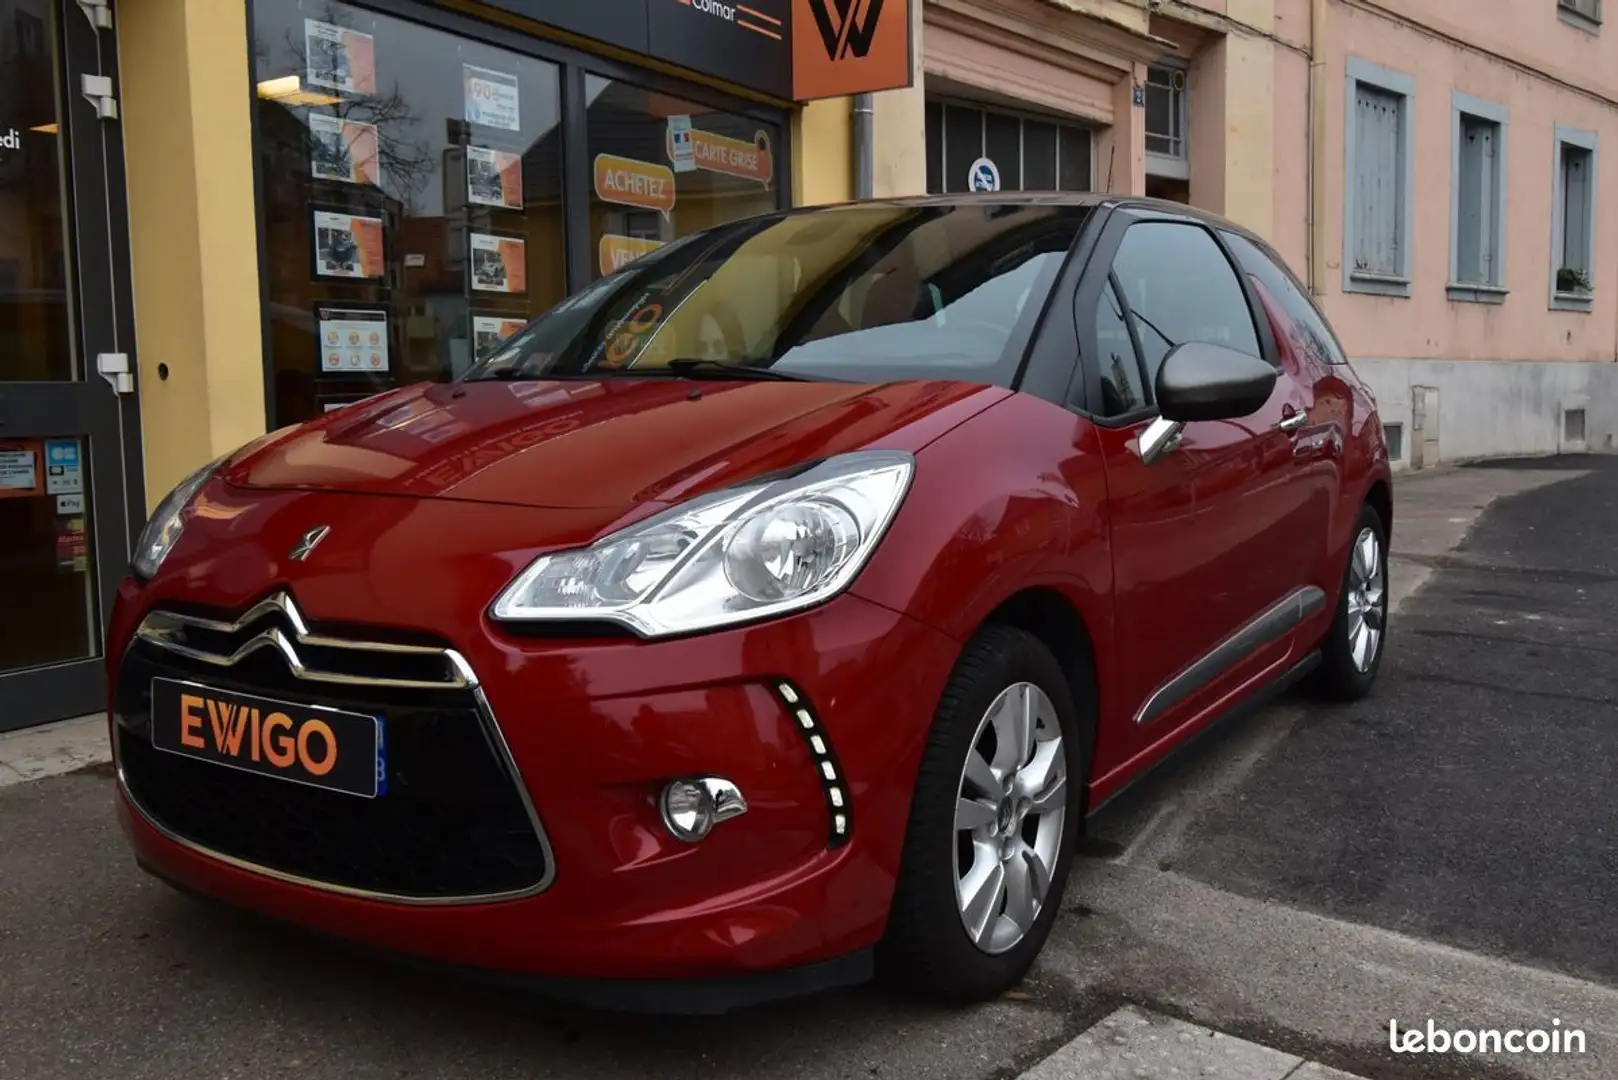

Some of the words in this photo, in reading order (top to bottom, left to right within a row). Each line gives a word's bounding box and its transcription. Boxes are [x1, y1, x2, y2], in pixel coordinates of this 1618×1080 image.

[692, 0, 736, 21] Colmar
[694, 140, 728, 165] CARTE
[728, 150, 758, 171] GRISE
[604, 168, 666, 199] ACHETEZ
[180, 693, 338, 776] EWIGO
